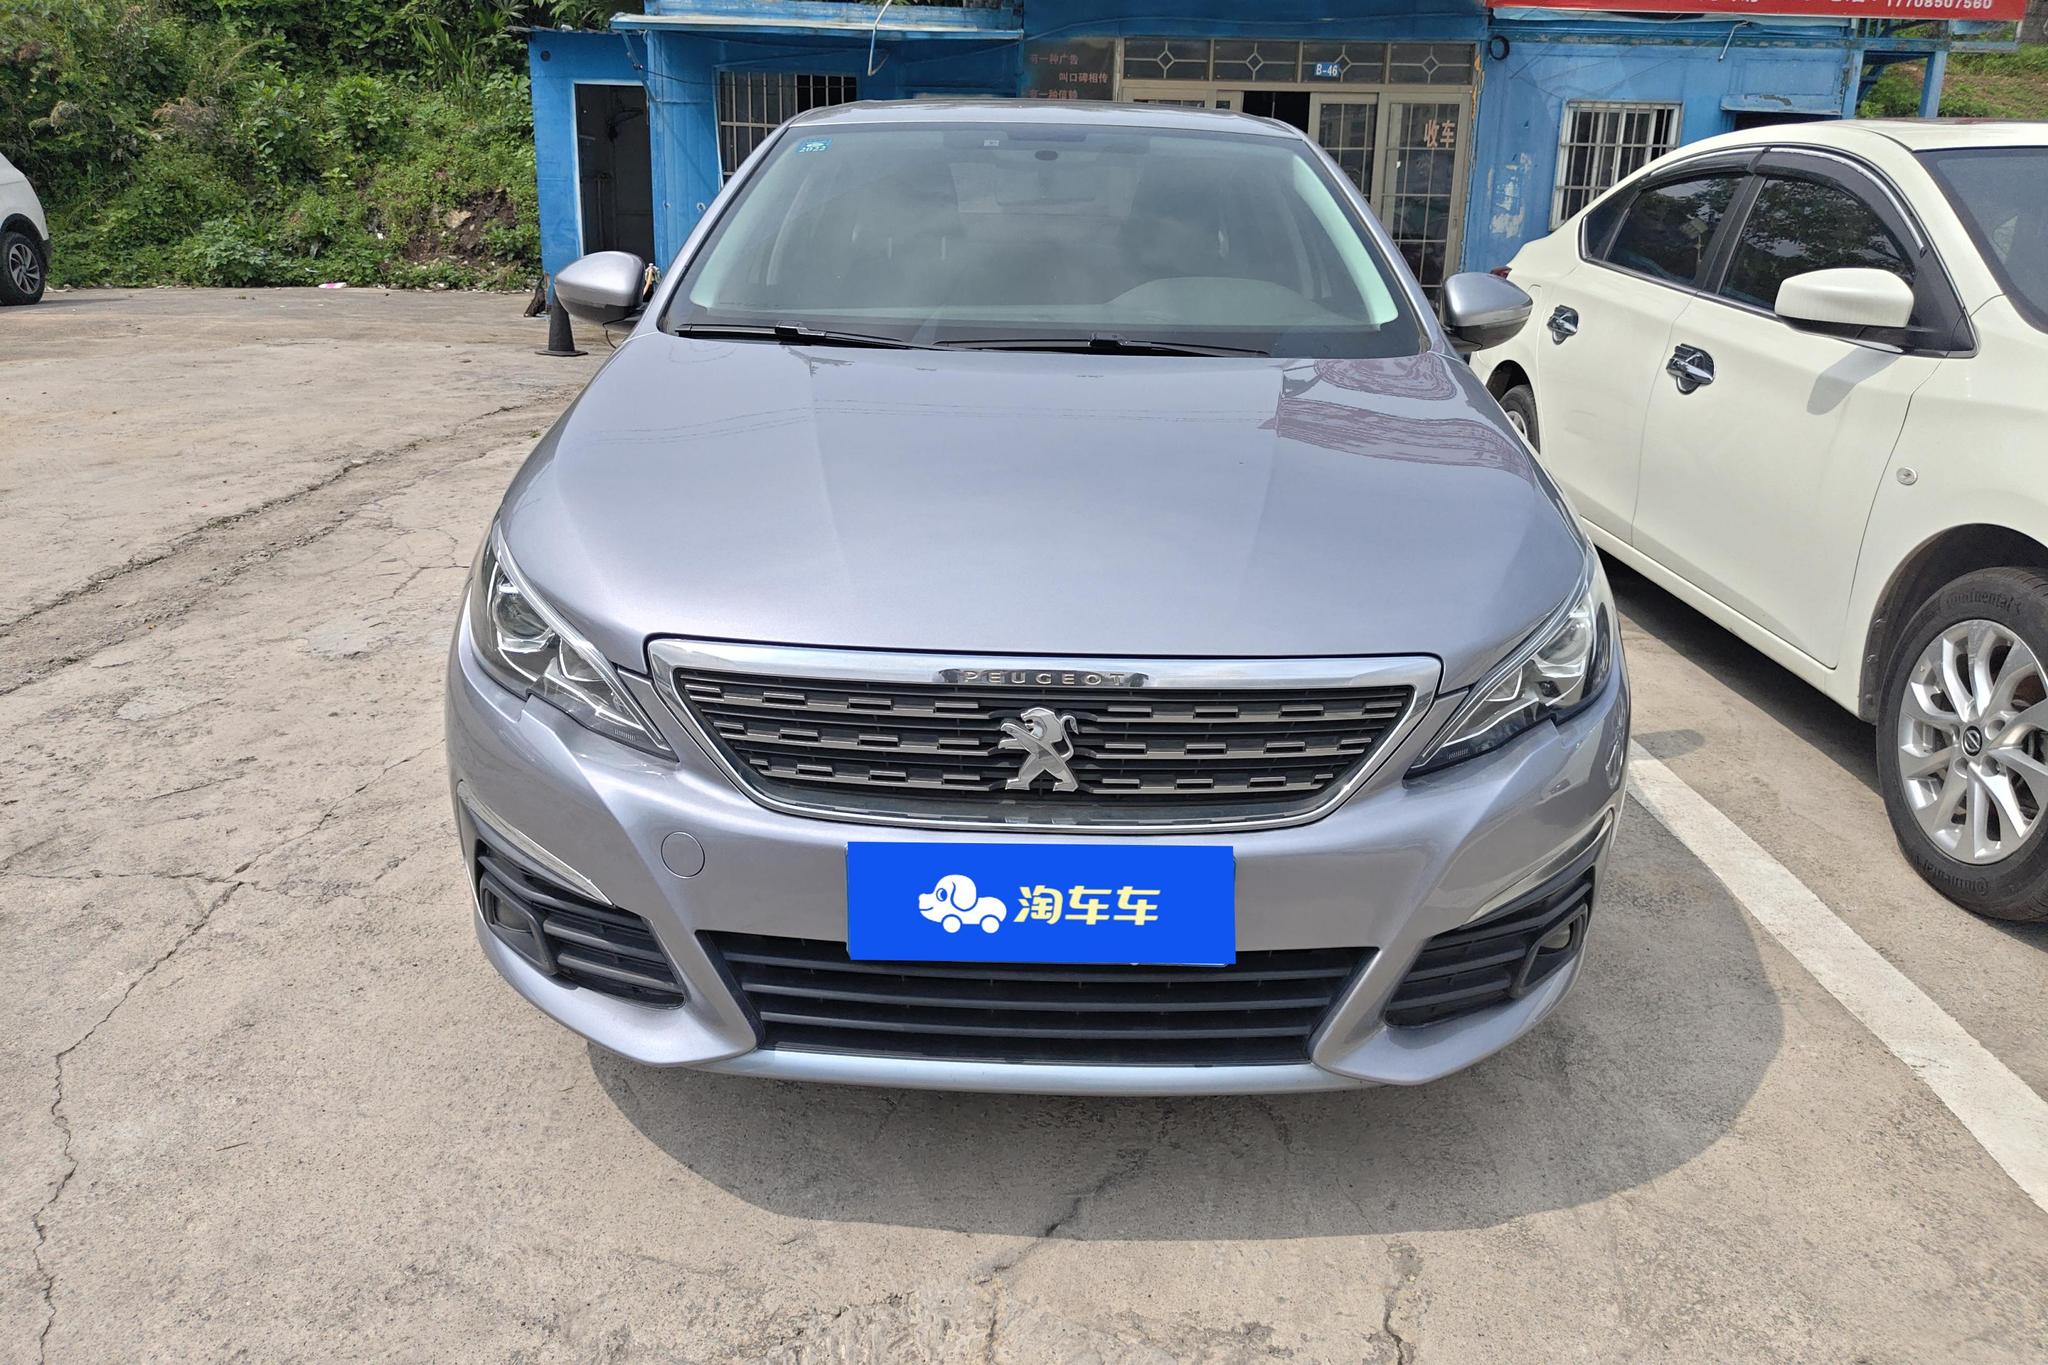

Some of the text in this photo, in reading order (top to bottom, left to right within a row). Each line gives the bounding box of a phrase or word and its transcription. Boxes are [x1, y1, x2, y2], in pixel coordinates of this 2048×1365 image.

[1059, 71, 1108, 83] 叫口碑相传
[1316, 63, 1338, 77] B-46
[1424, 119, 1456, 149] 收车
[963, 671, 1126, 686] PEUGEOT
